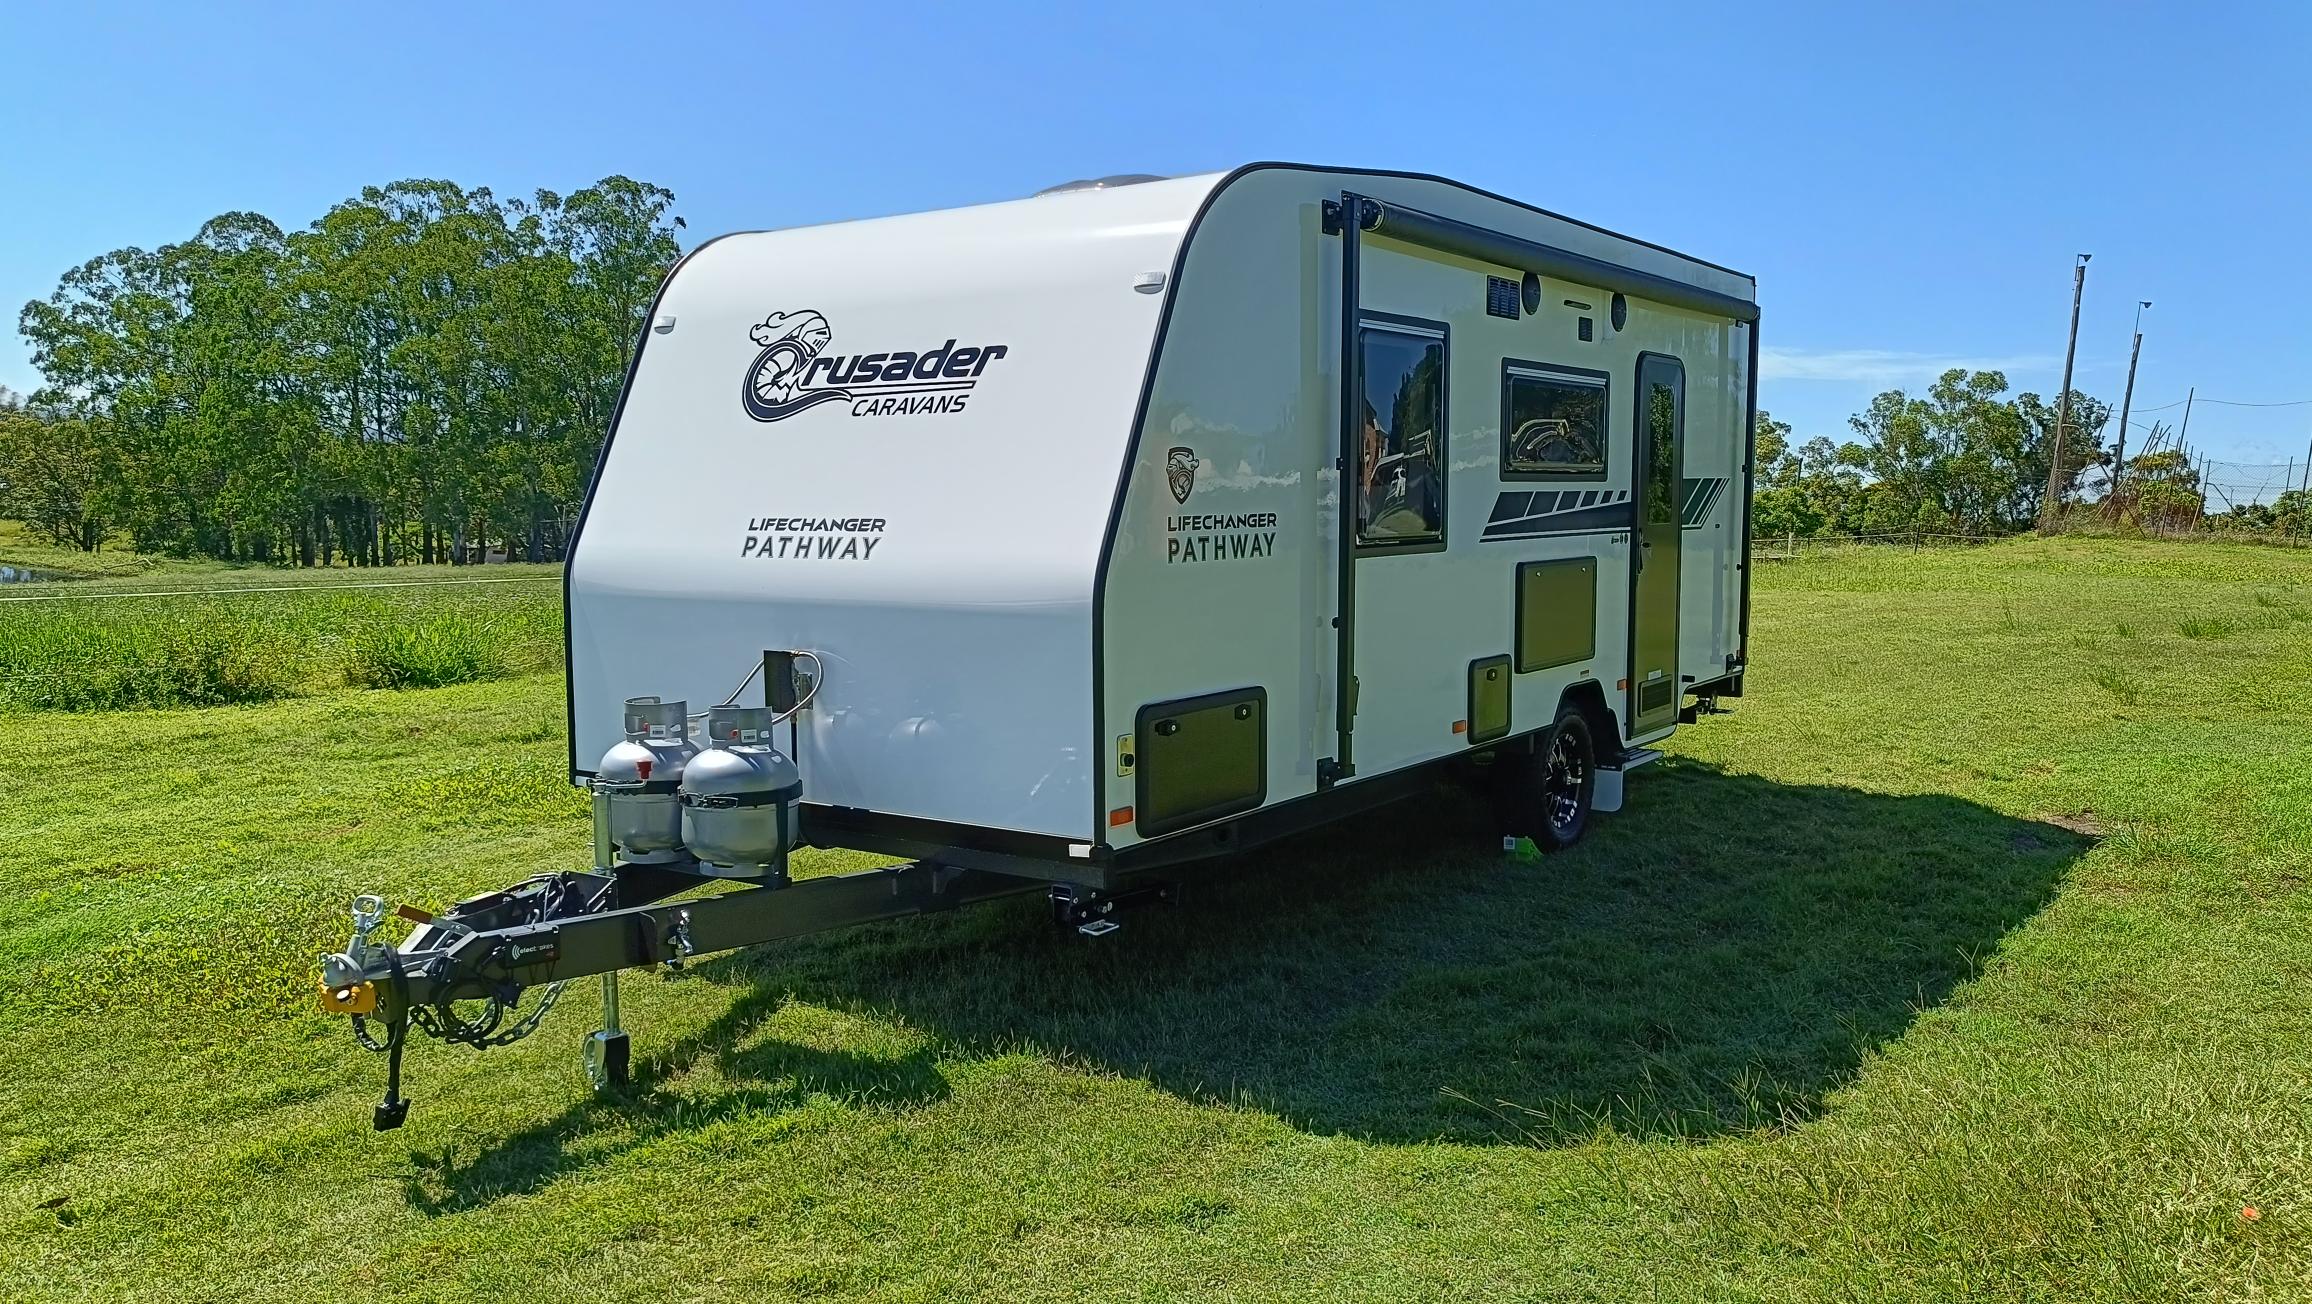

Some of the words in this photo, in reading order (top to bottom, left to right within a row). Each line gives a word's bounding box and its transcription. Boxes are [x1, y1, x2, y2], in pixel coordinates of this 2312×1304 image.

[742, 338, 1009, 423] Crusader
[851, 394, 970, 417] CARAVANS
[748, 517, 886, 533] LIFECHANGER
[1167, 512, 1277, 532] LIFECHANGER
[741, 535, 882, 560] PATHWAY
[1167, 532, 1276, 564] PATHWAY
